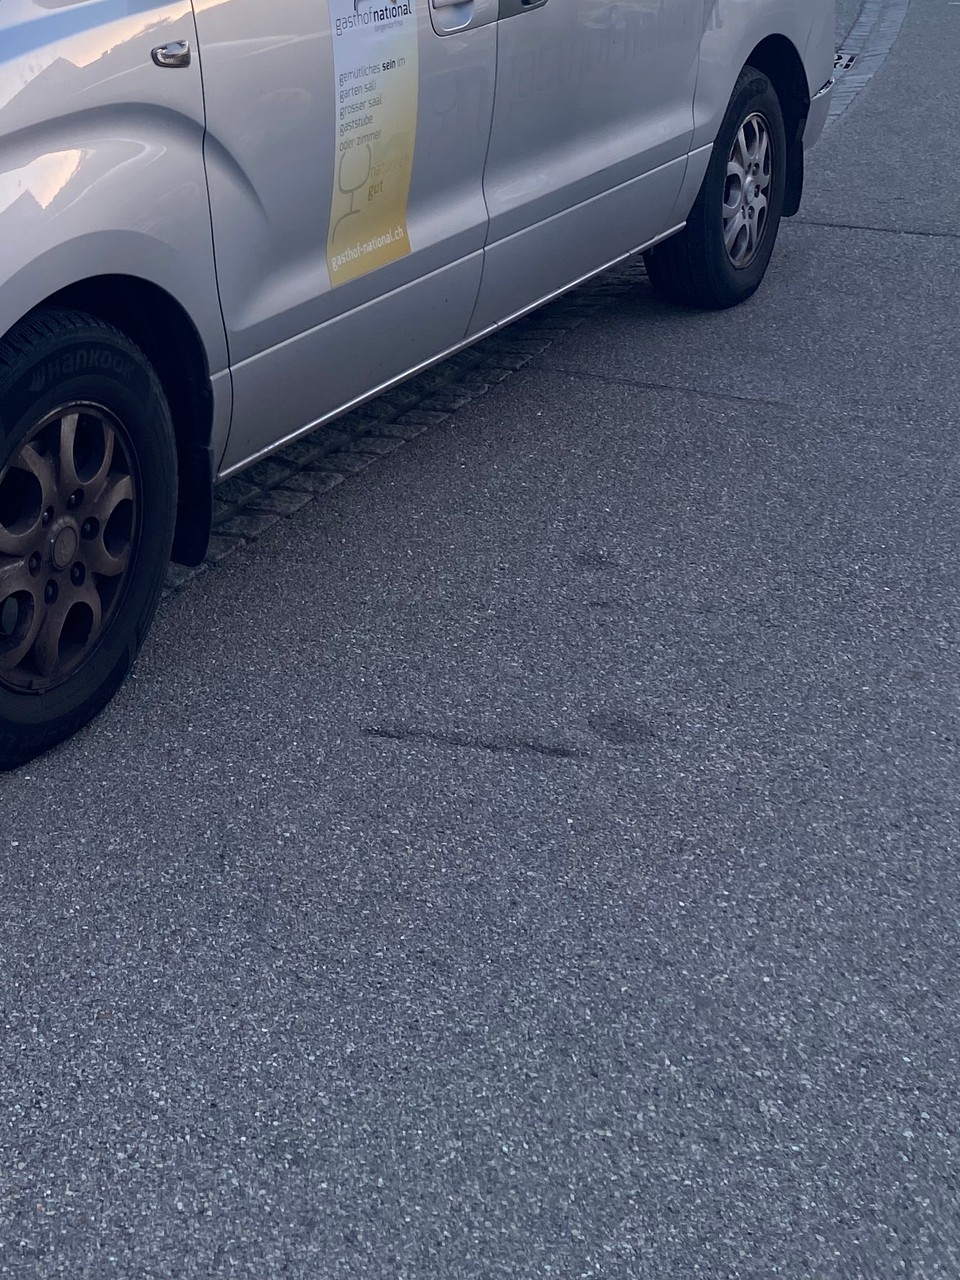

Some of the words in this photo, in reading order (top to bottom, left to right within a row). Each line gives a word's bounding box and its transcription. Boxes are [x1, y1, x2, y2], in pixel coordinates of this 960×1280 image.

[382, 59, 396, 71] sein
[340, 100, 367, 120] grosser
[340, 114, 373, 137] gaststube
[339, 138, 355, 152] oder
[356, 130, 382, 146] zimmer
[367, 180, 383, 202] gut
[331, 226, 404, 272] gasthof-national.ch
